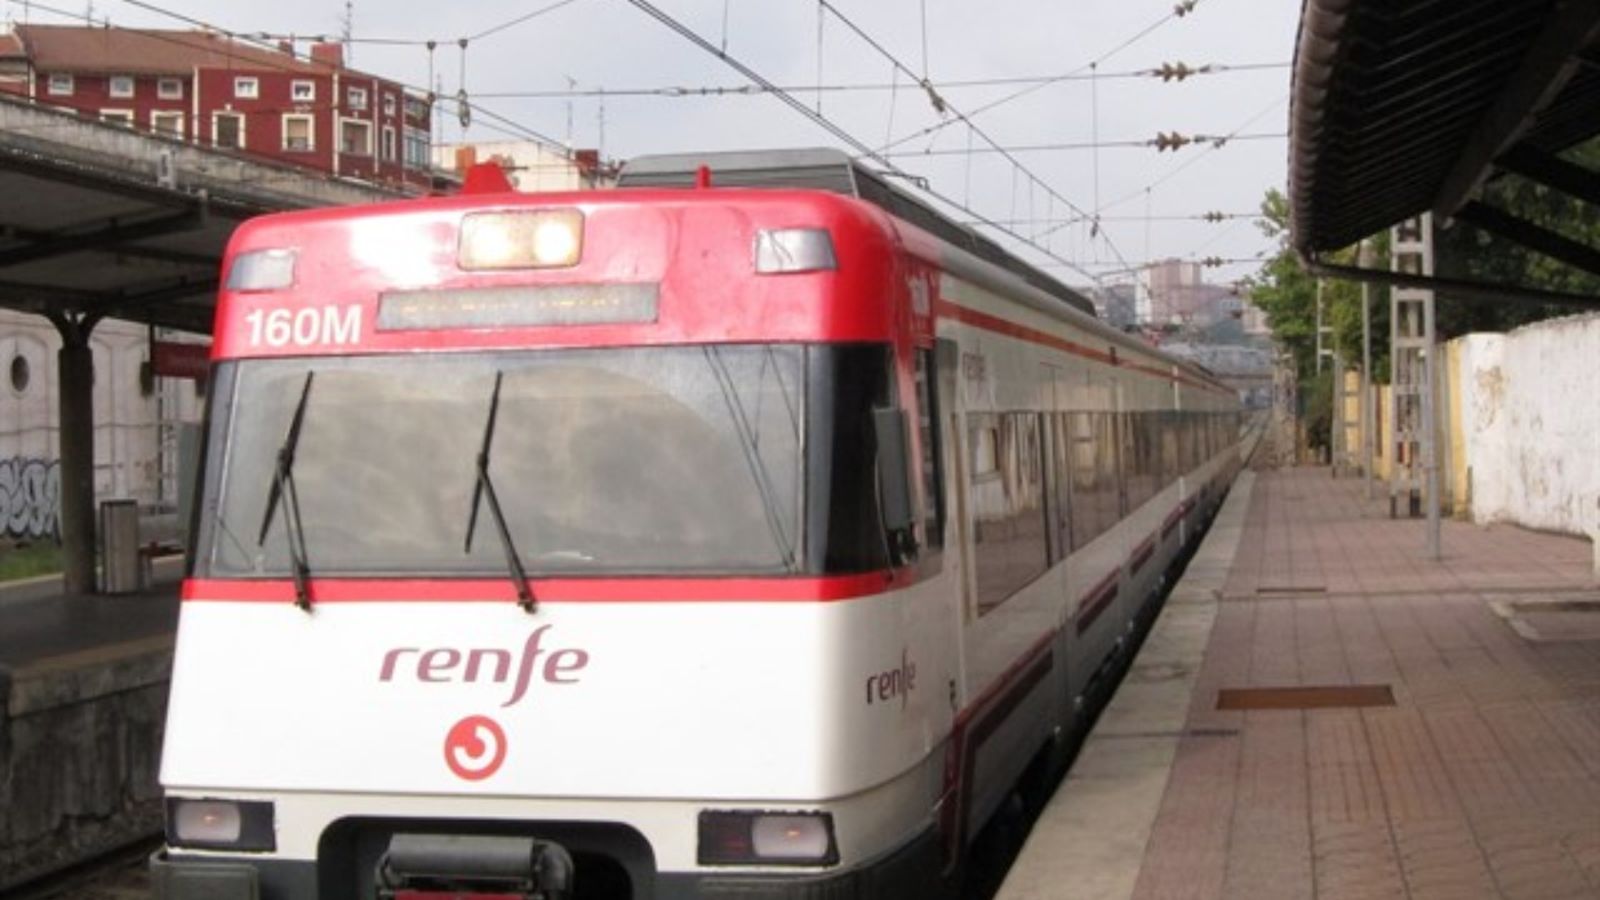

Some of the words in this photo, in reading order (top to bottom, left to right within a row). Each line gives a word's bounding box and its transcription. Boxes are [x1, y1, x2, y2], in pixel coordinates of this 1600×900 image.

[245, 304, 362, 347] 160M
[379, 624, 590, 708] renfe
[866, 646, 916, 711] renfe
